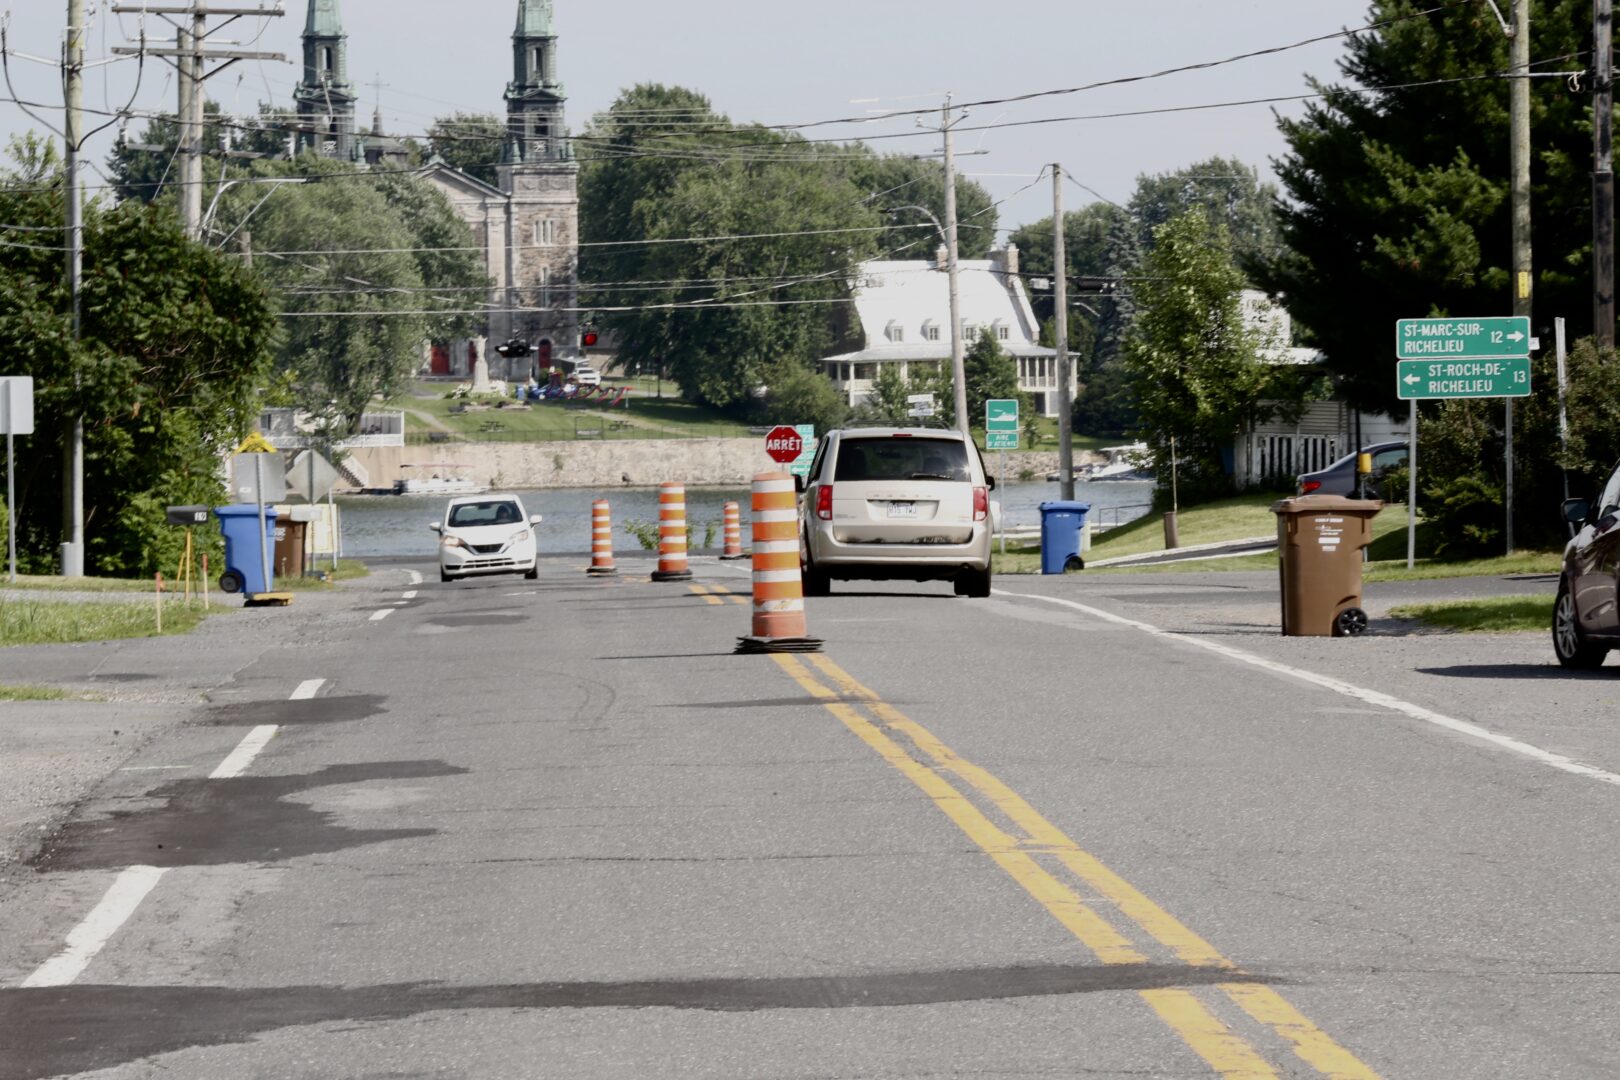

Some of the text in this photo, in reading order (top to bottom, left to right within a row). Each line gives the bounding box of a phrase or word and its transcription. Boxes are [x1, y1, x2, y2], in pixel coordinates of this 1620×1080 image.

[1404, 323, 1484, 337] ST-MARC-SUR-
[1491, 331, 1503, 343] 12
[1405, 339, 1464, 353] RICHELIEU
[1428, 363, 1506, 377] ST-ROCH-DE-
[1513, 371, 1526, 383] 13
[1428, 380, 1492, 393] RICHELIEU
